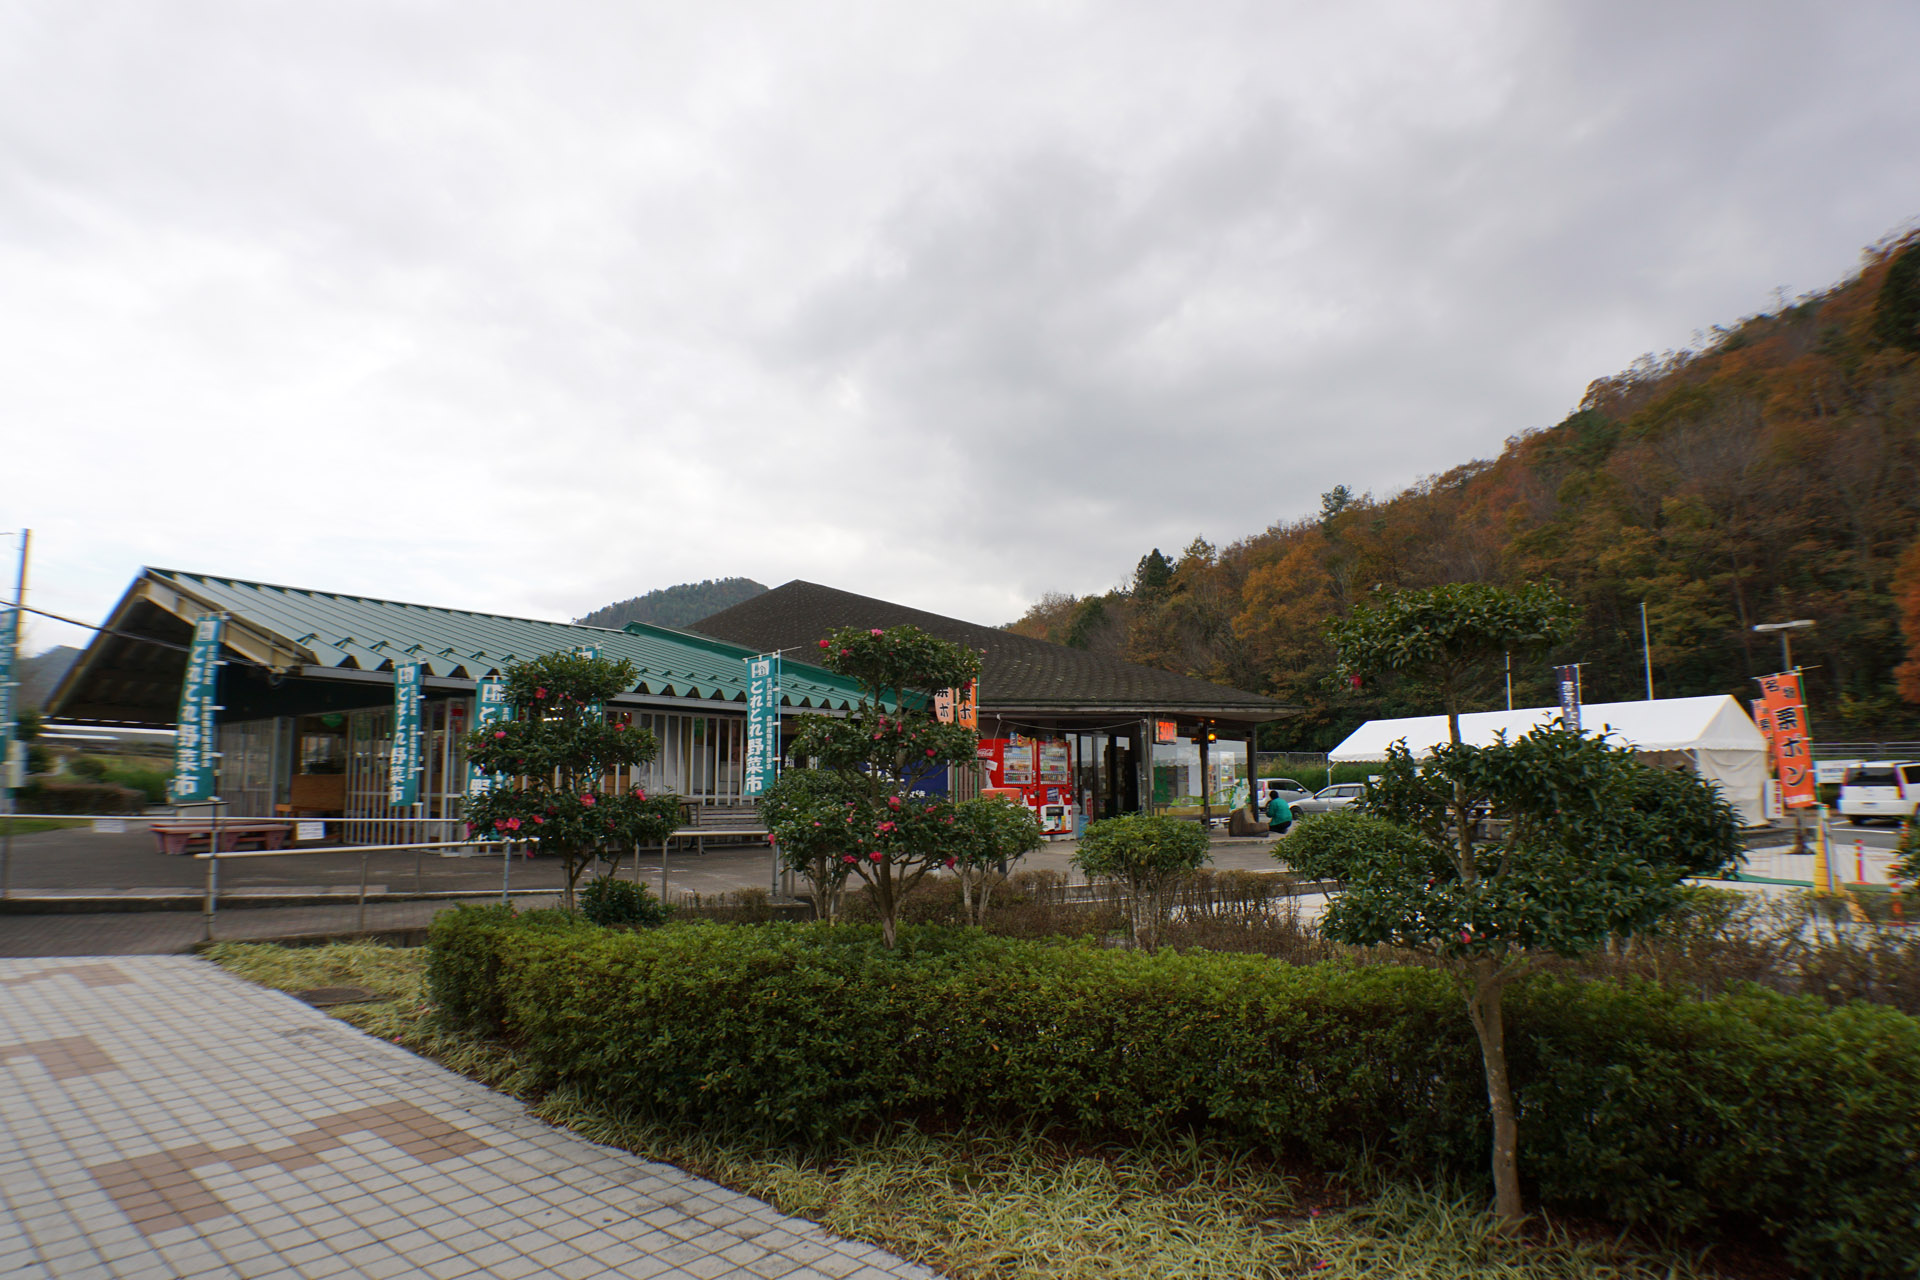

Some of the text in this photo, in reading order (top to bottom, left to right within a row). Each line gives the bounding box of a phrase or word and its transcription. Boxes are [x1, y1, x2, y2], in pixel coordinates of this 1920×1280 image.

[746, 680, 764, 793] とれとれ野菜市
[1775, 706, 1806, 787] 栗ポン
